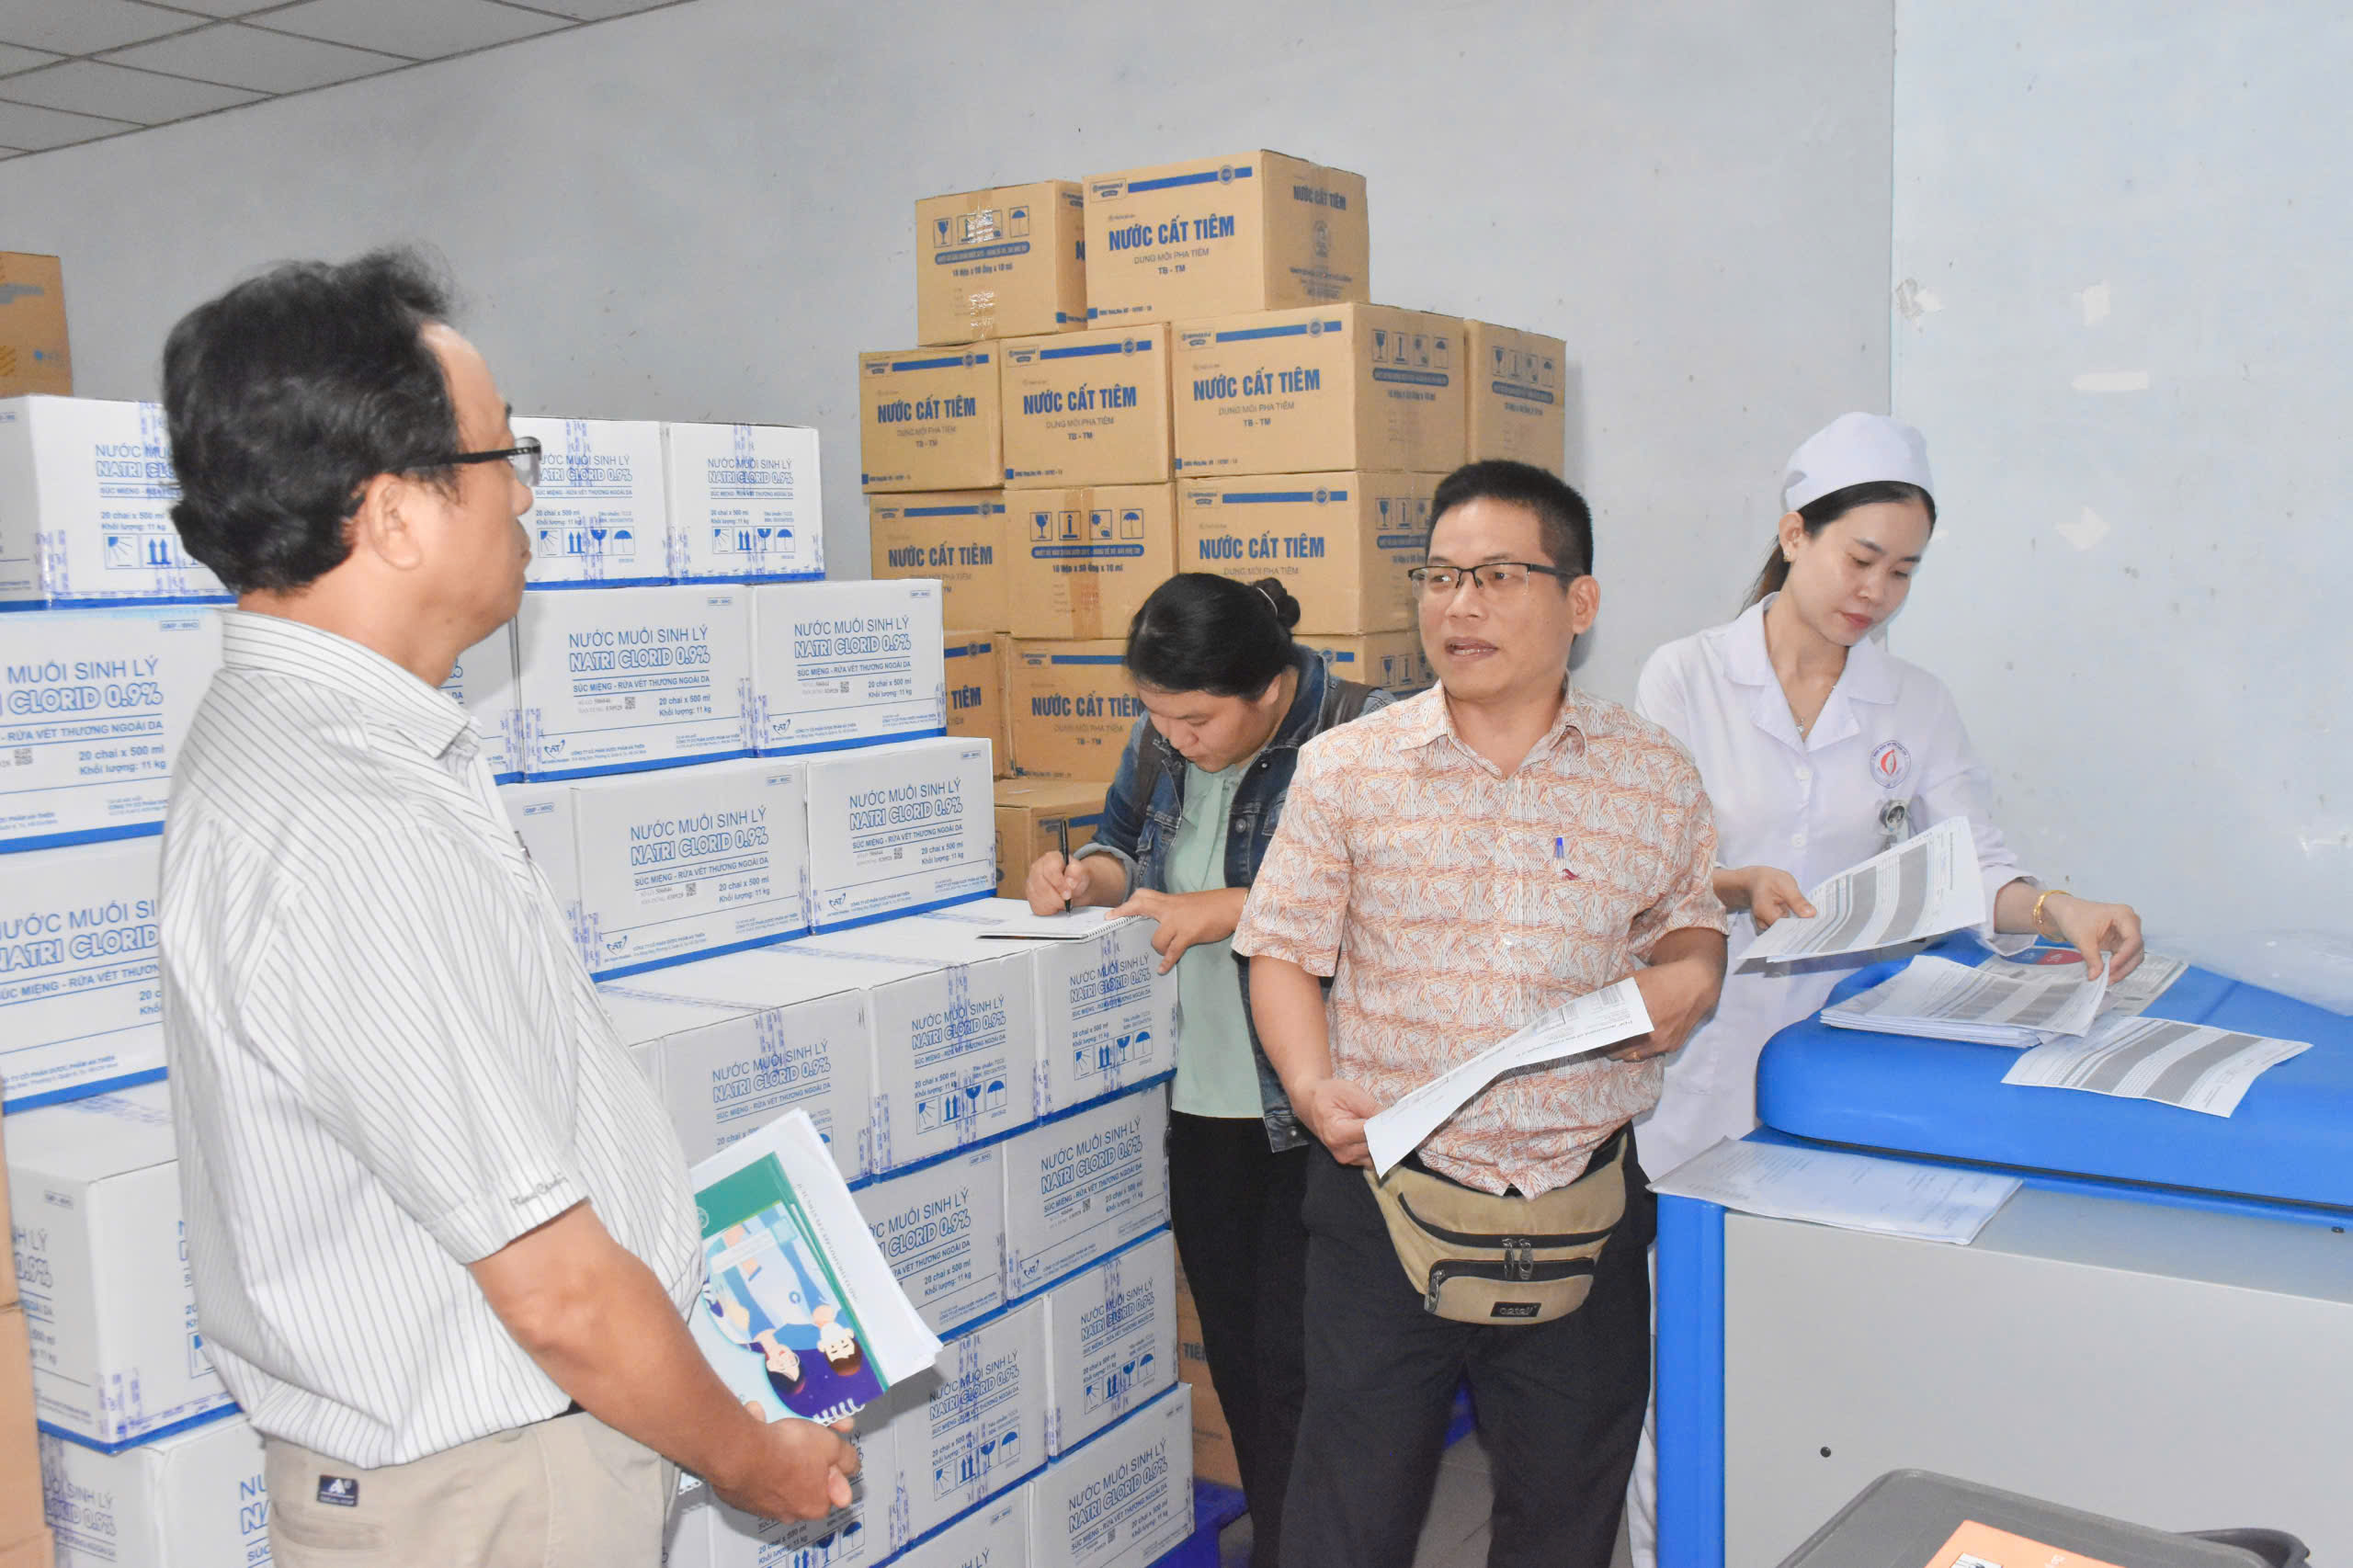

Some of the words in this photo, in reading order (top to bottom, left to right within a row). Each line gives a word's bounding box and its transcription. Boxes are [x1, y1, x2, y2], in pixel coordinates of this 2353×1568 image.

[1108, 224, 1153, 251] NƯỚC
[1158, 214, 1188, 246] CẤT
[1193, 212, 1234, 241] TIÊM
[1023, 391, 1063, 415] NƯỚC
[1068, 383, 1095, 410] CẤT
[1099, 383, 1136, 407] TIÊM
[1194, 374, 1237, 401] NƯỚC
[1244, 367, 1274, 395] CẤT
[1279, 366, 1320, 392] TIÊM
[878, 402, 912, 423] NƯỚC
[915, 395, 940, 420] CẤT
[944, 395, 975, 417] TIÊM
[708, 458, 734, 470] NƯỚC
[736, 458, 758, 469] MUỐI
[760, 460, 779, 469] SINH
[781, 458, 791, 469] LÝ
[709, 472, 735, 484] NATRI
[737, 472, 770, 484] CLORID
[772, 472, 793, 484] 0.9%
[889, 546, 924, 567] NƯỚC
[929, 540, 955, 566] CẤT
[959, 543, 993, 565] TIÊM
[1199, 535, 1243, 559] NƯỚC
[1248, 530, 1279, 558] CẤT
[1284, 533, 1324, 558] TIÊM
[569, 630, 614, 648] NƯỚC
[619, 628, 653, 645] MUỐI
[658, 629, 688, 642] SINH
[693, 625, 707, 641] LÝ
[794, 619, 831, 637] NƯỚC
[835, 618, 864, 634] MUỐI
[868, 618, 892, 631] SINH
[896, 615, 909, 630] LÝ
[570, 651, 615, 672] NATRI
[619, 647, 673, 669] CLORID
[676, 645, 710, 665] 0.9%
[795, 640, 832, 658] NATRI
[835, 636, 880, 655] CLORID
[882, 633, 911, 652] 0.9%
[7, 660, 66, 684] MUỐI
[75, 661, 126, 680] SINH
[134, 655, 159, 676] LÝ
[8, 687, 101, 715] CLORID
[105, 682, 163, 709] 0.9%
[669, 696, 682, 704] chai
[951, 685, 981, 710] TIÊM
[1032, 694, 1071, 717] NƯỚC
[1076, 691, 1103, 717] CẤT
[79, 752, 92, 760] 20
[96, 748, 117, 759] chai
[131, 747, 147, 756] 500
[152, 744, 164, 754] ml
[849, 791, 885, 809] NƯỚC
[889, 784, 916, 802] MUỐI
[921, 784, 945, 797] SINH
[948, 778, 961, 793] LÝ
[631, 820, 675, 841] NƯỚC
[678, 814, 712, 834] MUỐI
[717, 811, 747, 828] SINH
[752, 805, 767, 824] LÝ
[850, 808, 886, 830] NATRI
[889, 801, 932, 824] CLORID
[935, 797, 963, 817] 0.9%
[631, 840, 675, 866] NATRI
[679, 831, 732, 858] CLORID
[735, 826, 768, 849] 0.9%
[69, 900, 128, 929] MUỐI
[71, 924, 159, 960] CLORID
[1070, 970, 1096, 986] NƯỚC
[1097, 964, 1119, 979] MUỐI
[1120, 957, 1138, 972] SINH
[1140, 952, 1149, 966] LÝ
[1071, 983, 1097, 1004] NATRI
[1099, 975, 1129, 994] CLORID
[1131, 967, 1150, 985] 0.9%
[912, 1012, 941, 1031] NƯỚC
[944, 1005, 966, 1023] MUỐI
[970, 999, 991, 1016] SINH
[995, 994, 1005, 1010] LÝ
[912, 1028, 942, 1050] NATRI
[945, 1018, 981, 1041] CLORID
[983, 1012, 1006, 1031] 0.9%
[712, 1062, 750, 1083] NƯỚC
[754, 1053, 785, 1072] MUỐI
[787, 1044, 813, 1062] SINH
[815, 1039, 827, 1055] LÝ
[713, 1078, 751, 1103] NATRI
[754, 1065, 799, 1092] CLORID
[801, 1057, 831, 1078] 0.9%
[1041, 1148, 1074, 1172] NƯỚC
[1076, 1136, 1101, 1158] MUỐI
[1104, 1126, 1128, 1146] SINH
[1131, 1116, 1141, 1135] LÝ
[1040, 1167, 1074, 1194] NATRI
[1076, 1150, 1115, 1176] CLORID
[1117, 1135, 1142, 1159] 0.9%
[889, 1207, 919, 1233] MUỐI
[923, 1196, 952, 1220] SINH
[956, 1187, 969, 1208] LÝ
[889, 1225, 938, 1257] CLORID
[939, 1209, 971, 1237] 0.9%
[929, 1380, 958, 1403] NƯỚC
[961, 1369, 983, 1389] MUỐI
[985, 1358, 1005, 1378] SINH
[1007, 1348, 1017, 1366] LÝ
[929, 1393, 959, 1421] NATRI
[961, 1377, 995, 1404] CLORID
[997, 1363, 1020, 1385] 0.9%
[1069, 1482, 1100, 1509] NƯỚC
[1103, 1466, 1129, 1492] MUỐI
[1131, 1450, 1153, 1476] SINH
[1155, 1438, 1166, 1460] LÝ
[1069, 1498, 1102, 1533] NATRI
[1103, 1476, 1141, 1511] CLORID
[1143, 1458, 1167, 1484] 0.9%
